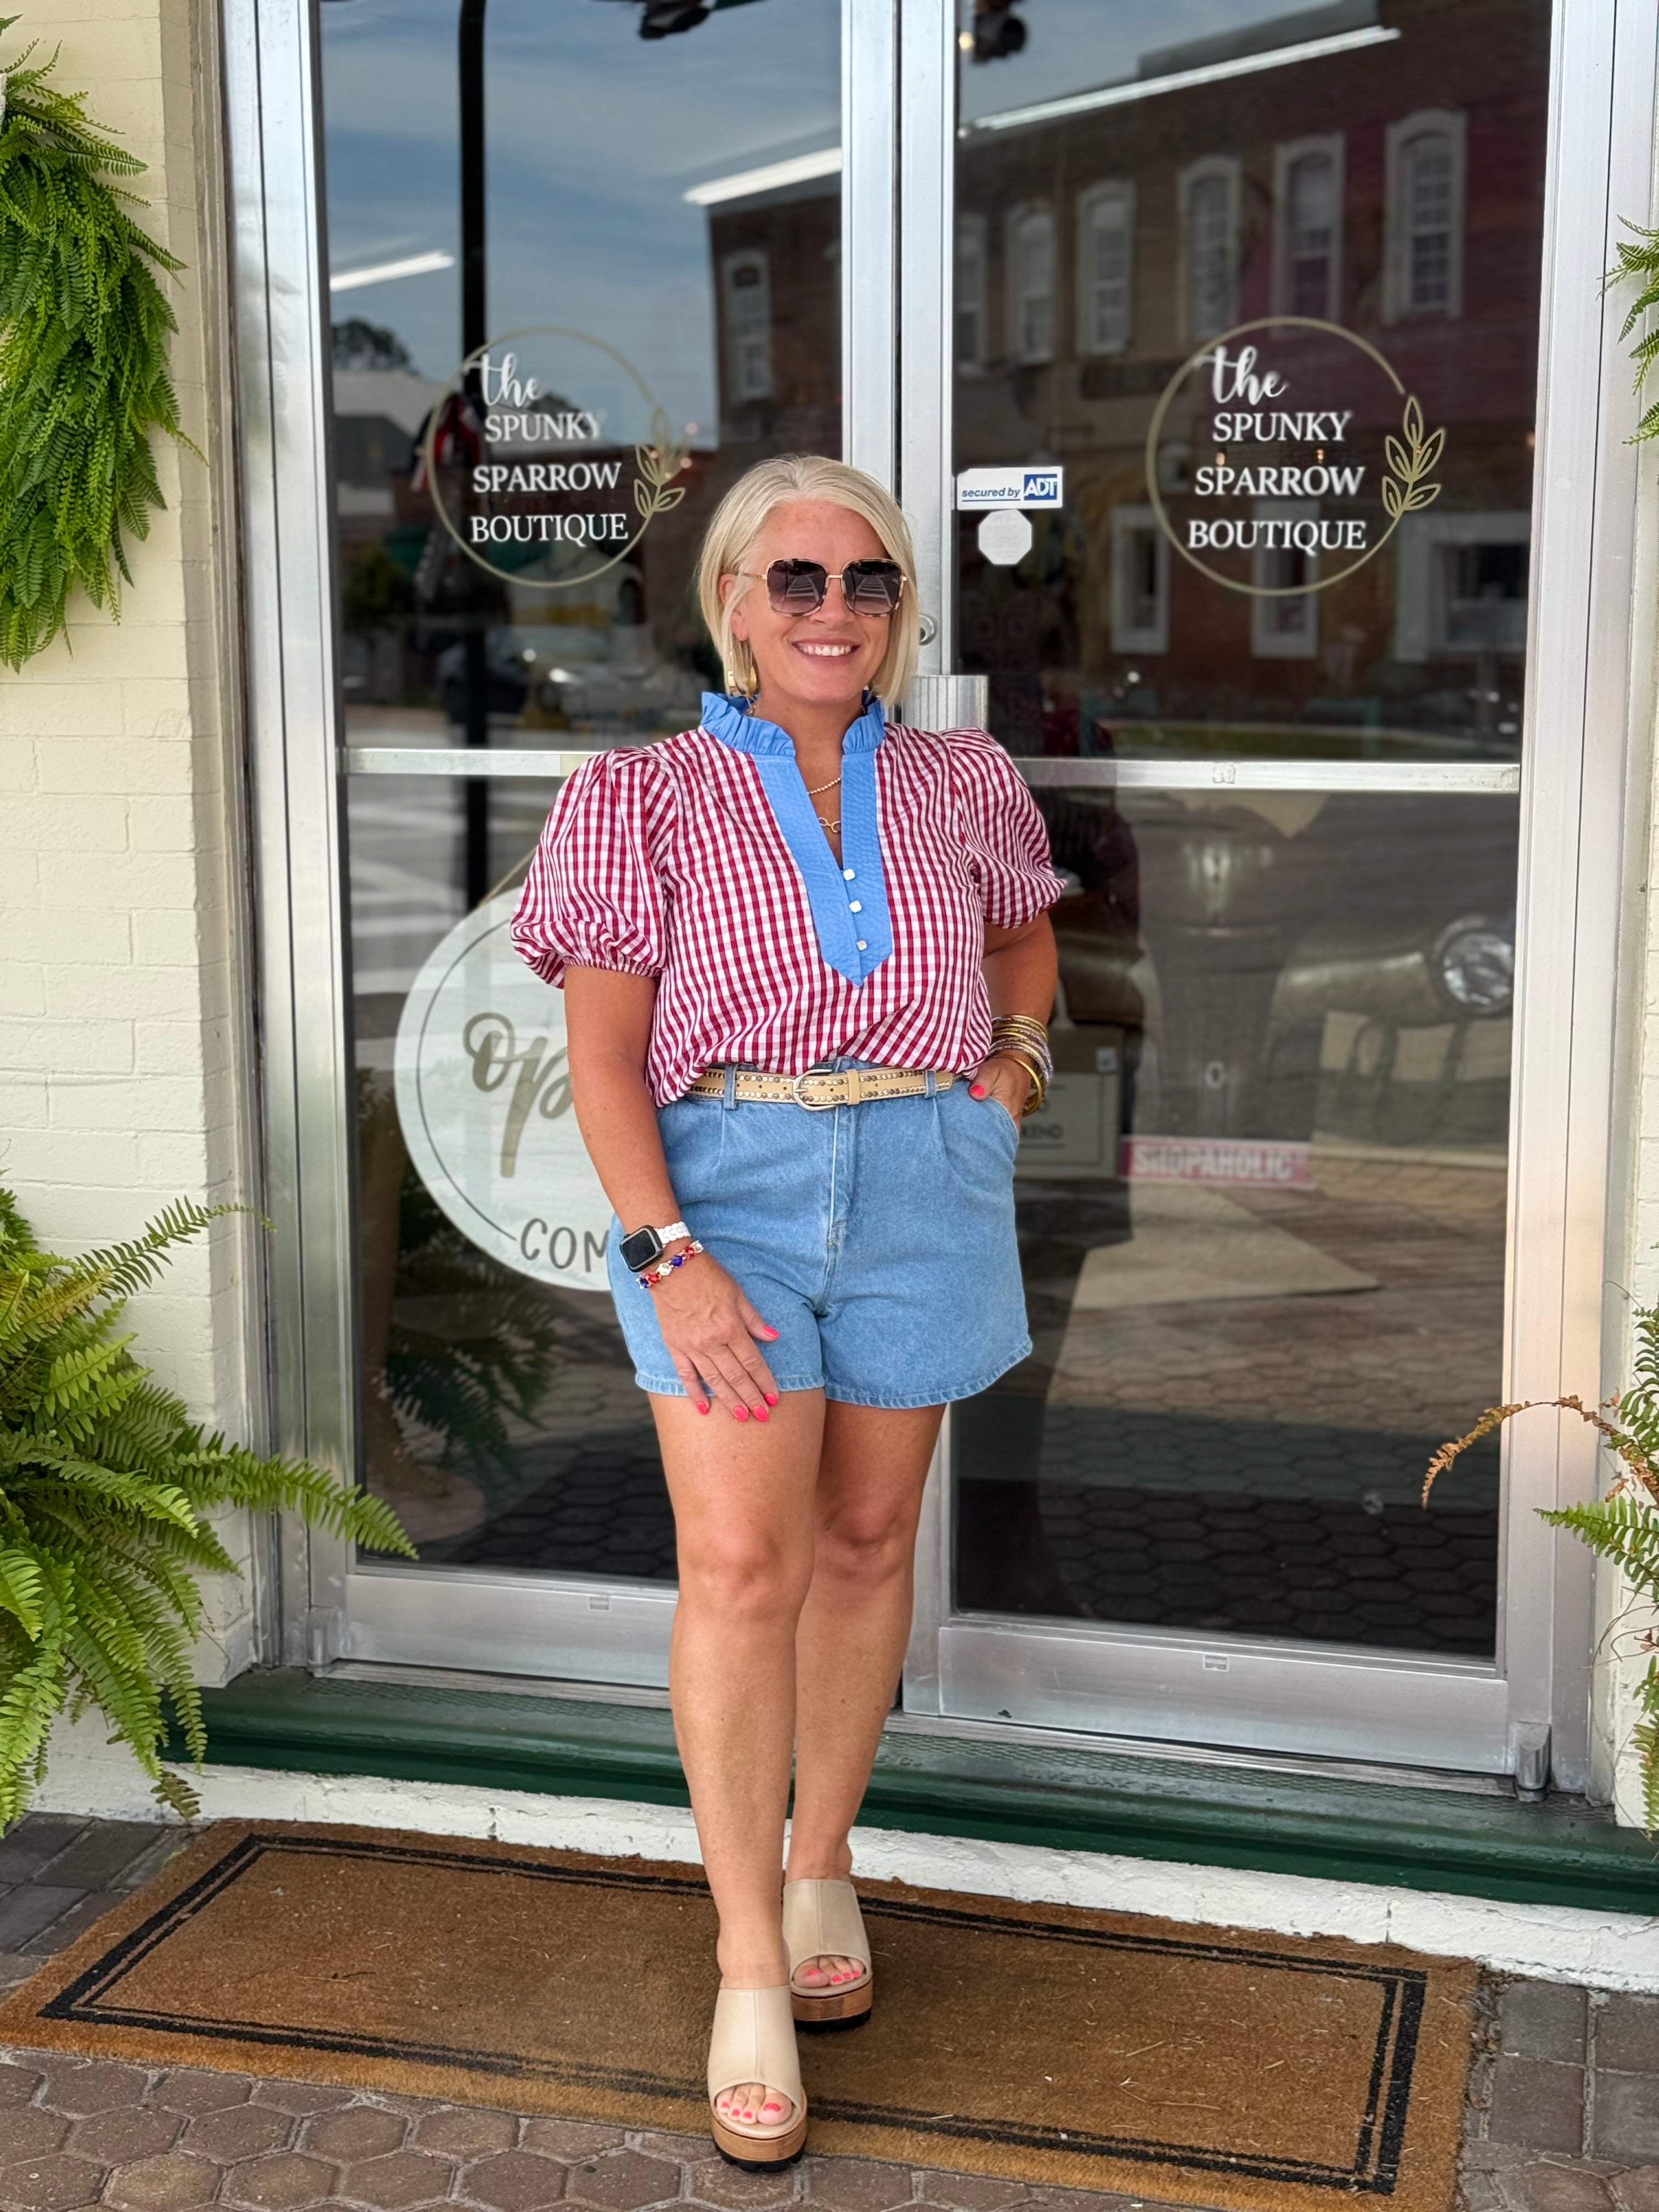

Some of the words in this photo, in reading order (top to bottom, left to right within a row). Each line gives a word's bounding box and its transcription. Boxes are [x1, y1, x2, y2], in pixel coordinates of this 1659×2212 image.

[461, 352, 541, 407] the
[1193, 345, 1290, 405] the
[485, 411, 606, 441] SPUNKY
[1212, 411, 1353, 441] SPUNKY
[472, 462, 622, 493] SPARROW
[962, 487, 1006, 498] secured
[1008, 487, 1020, 498] by
[1024, 477, 1057, 496] ADT
[1195, 466, 1365, 495] SPARROW
[471, 514, 629, 547] BOUTIQUE
[1188, 520, 1367, 557] BOUTIQUE
[1133, 1144, 1293, 1180] SHOPAHOLIC
